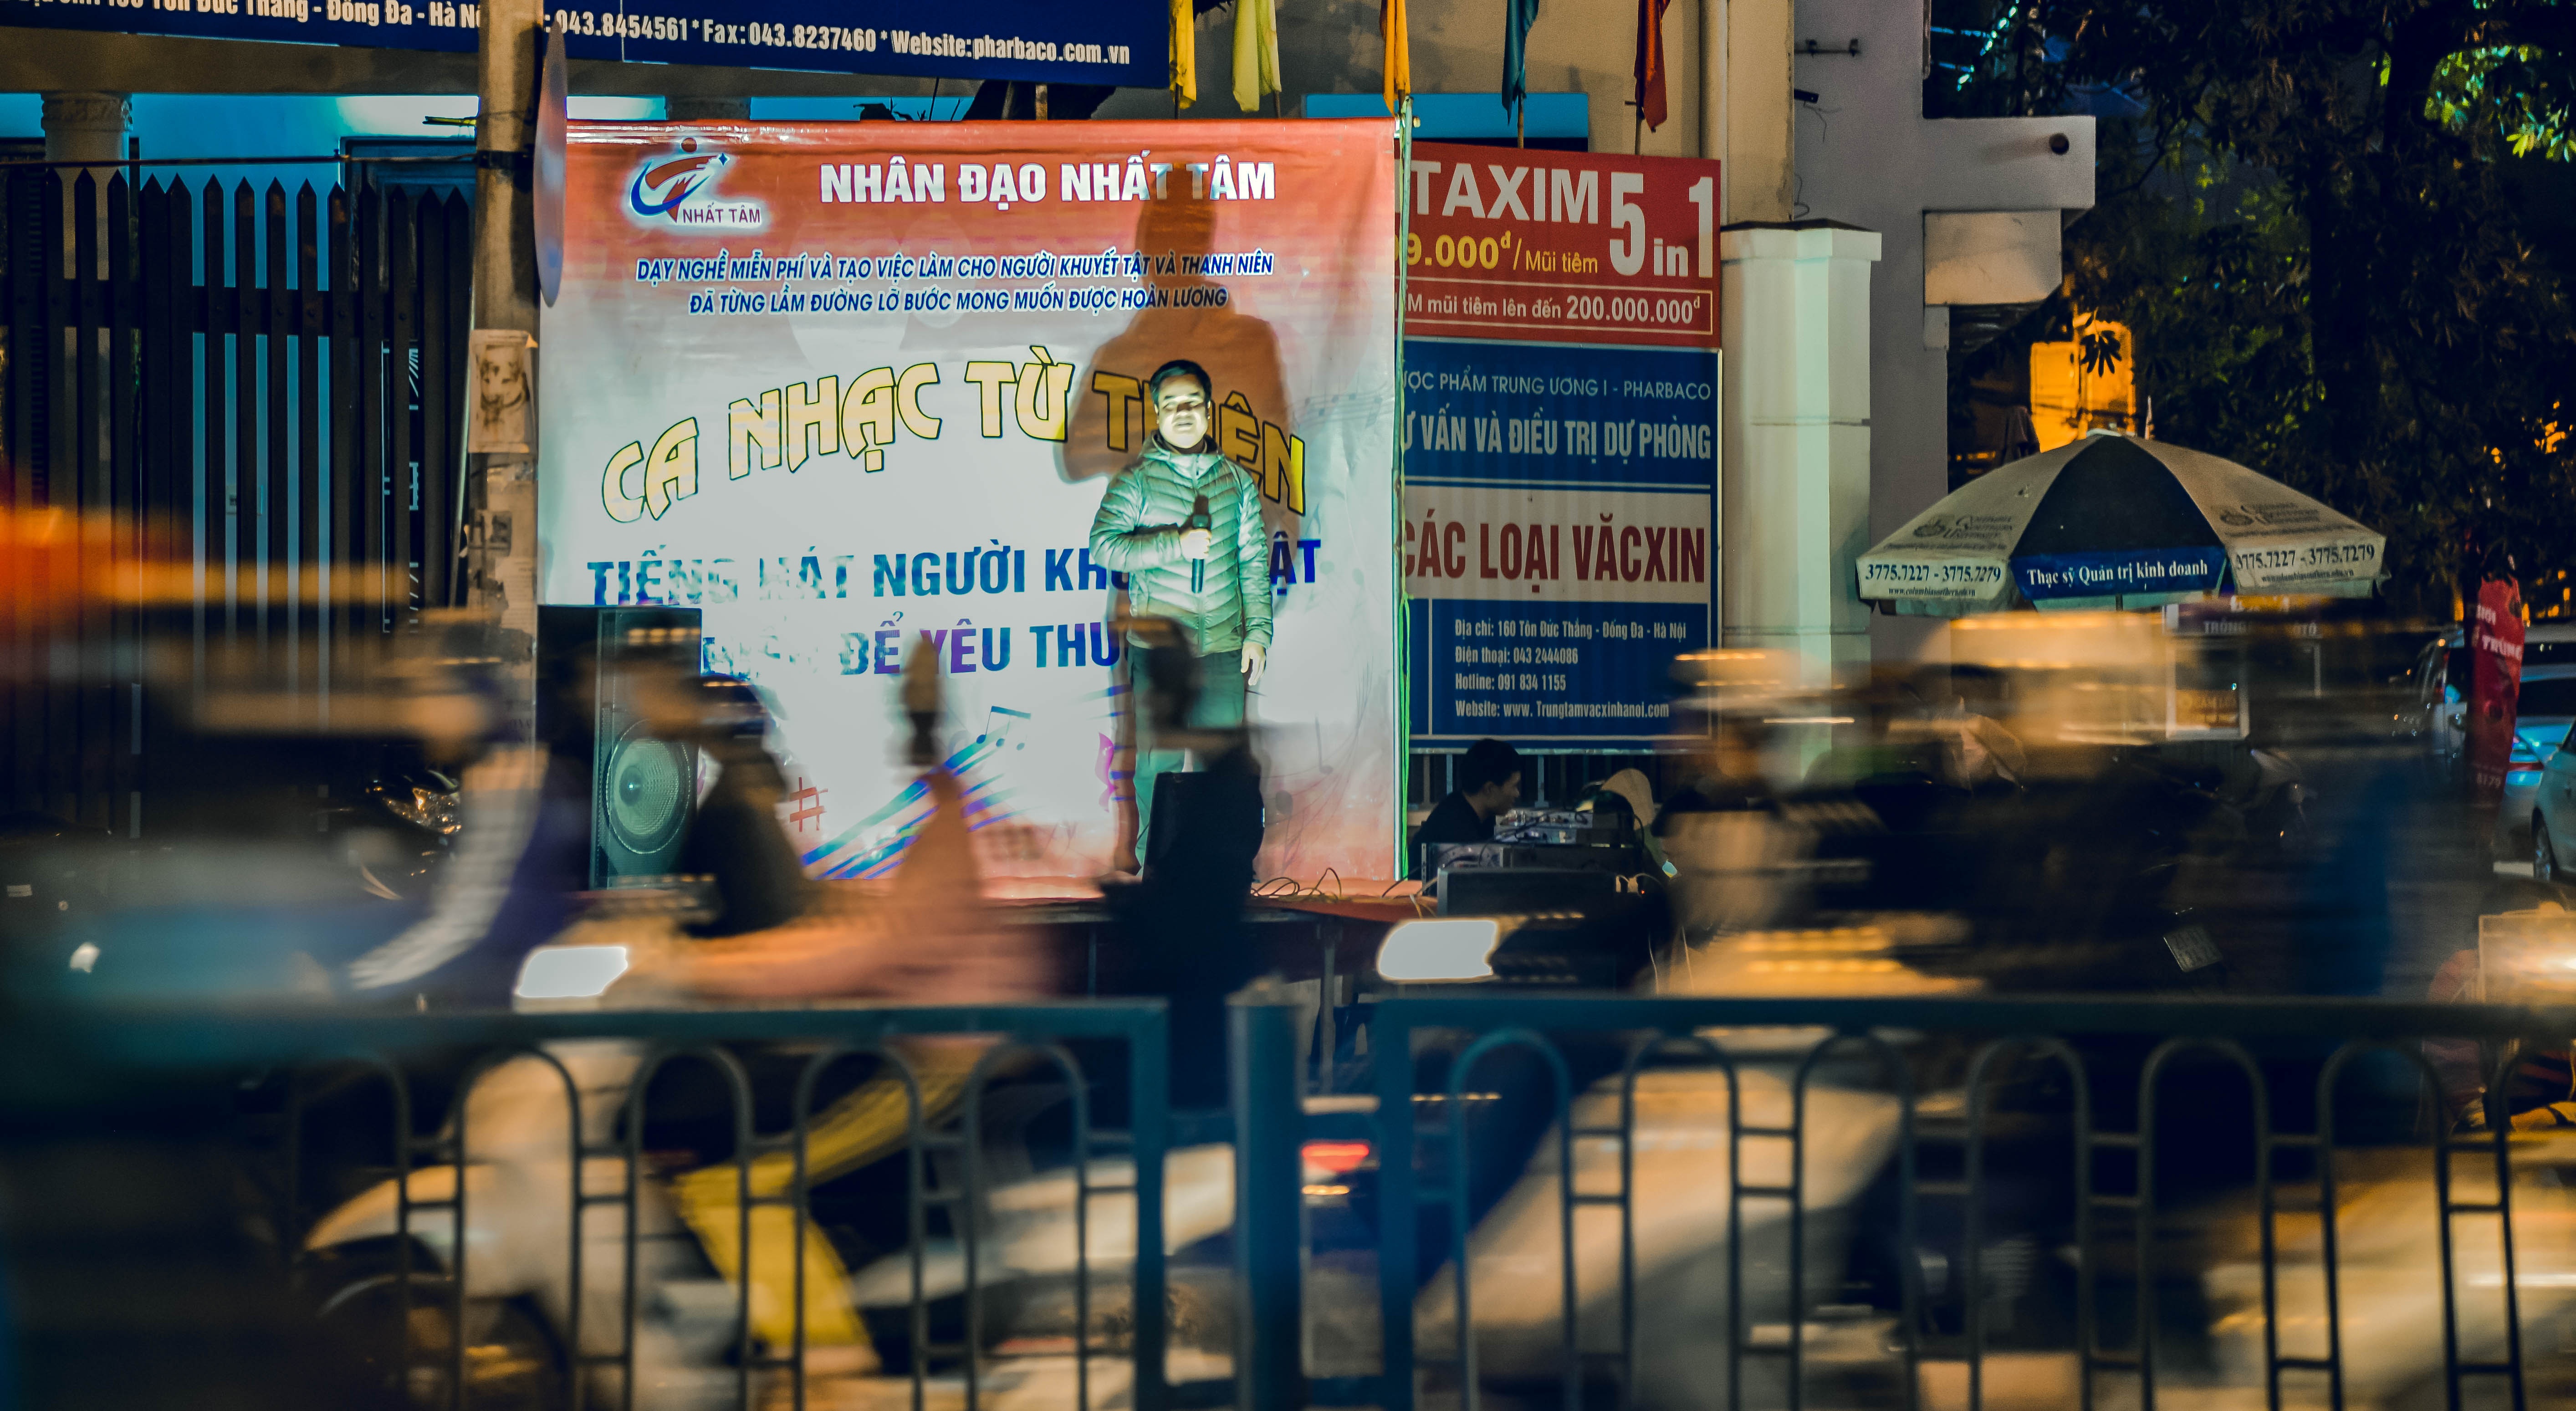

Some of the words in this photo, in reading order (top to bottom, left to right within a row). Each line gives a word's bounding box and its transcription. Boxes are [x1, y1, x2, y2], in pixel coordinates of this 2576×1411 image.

[385, 0, 412, 25] Đa
[429, 1, 455, 26] Hà
[821, 156, 945, 203] NHÂN
[957, 163, 1046, 211] ĐẠO
[1061, 149, 1174, 201] NHẤT
[1186, 154, 1276, 200] TÂM
[683, 201, 723, 224] NHẤT
[730, 205, 761, 224] TÂM
[637, 258, 676, 285] DẠY
[678, 249, 729, 280] NGHỀ
[731, 249, 772, 280] MIỄN
[776, 252, 806, 279] PHÍ
[810, 253, 833, 278] VÀ
[838, 259, 871, 285] TẠO
[877, 252, 914, 283] VIỆC
[918, 251, 953, 278] LÀM
[958, 257, 996, 277] CHO
[1000, 250, 1055, 278] NGƯỜI
[1059, 246, 1119, 277] KHUYẾT
[1122, 251, 1151, 281] TẬT
[1155, 251, 1177, 276] VÀ
[1181, 254, 1232, 276] THANH
[1237, 249, 1273, 276] NIÊN
[1562, 252, 1598, 273] tiêm
[690, 291, 715, 313] ĐÃ
[720, 287, 767, 313] TỪNG
[810, 288, 873, 312] ĐƯỜNG
[904, 287, 951, 311] BƯỚC
[956, 289, 1009, 310] MONG
[1014, 281, 1064, 310] MUỐN
[1068, 287, 1117, 313] ĐƯỢC
[1120, 285, 1168, 309] HOÀN
[1173, 287, 1228, 308] LƯƠNG
[1428, 295, 1457, 313] mũi
[1463, 296, 1497, 315] tiêm
[1503, 298, 1527, 318] lên
[1532, 297, 1561, 318] đến
[1440, 365, 1487, 392] PHẨM
[1492, 376, 1544, 395] TRUNG
[1550, 375, 1598, 397] ƯƠNG
[1603, 380, 1607, 396] I
[1623, 382, 1711, 401] PHARBACO
[602, 417, 699, 523] CA
[729, 361, 942, 481] NHẠC
[964, 344, 1075, 442] TỪ
[1421, 403, 1466, 452] VẤN
[1474, 410, 1502, 452] VÀ
[1508, 407, 1557, 454] ĐIỀU
[1564, 421, 1597, 464] TRỊ
[1604, 420, 1635, 465] DỰ
[1640, 415, 1711, 459] PHÒNG
[1402, 509, 1466, 579] CÁC
[1480, 522, 1559, 595] LOẠI
[1572, 513, 1705, 583] VĂCXIN
[874, 539, 1025, 597] NGƯỜI
[1865, 564, 1929, 581] 3775.7227
[1942, 565, 2001, 582] 3775.7279
[2027, 569, 2059, 588] Thạc
[2079, 564, 2114, 586] Quản
[2118, 562, 2133, 583] trị
[2136, 561, 2165, 578] kinh
[2169, 559, 2208, 577] doanh
[839, 611, 903, 676] ĐỂ
[1455, 619, 1472, 640] Địa
[1498, 620, 1516, 636] 160
[1519, 620, 1537, 637] Tôn
[1540, 619, 1559, 637] Đức
[1631, 621, 1643, 638] Đa
[1654, 622, 1666, 638] Hà
[1670, 622, 1686, 643] Nội
[1455, 646, 1478, 667] Điện
[1482, 646, 1510, 667] thoại:
[1513, 647, 1532, 664] 043
[1535, 647, 1578, 664] 2444086
[1456, 673, 1494, 690] Hotline:
[1498, 674, 1515, 690] 091
[1520, 674, 1538, 691] 834
[1542, 674, 1566, 691] 1155
[1456, 700, 1500, 717] Website:
